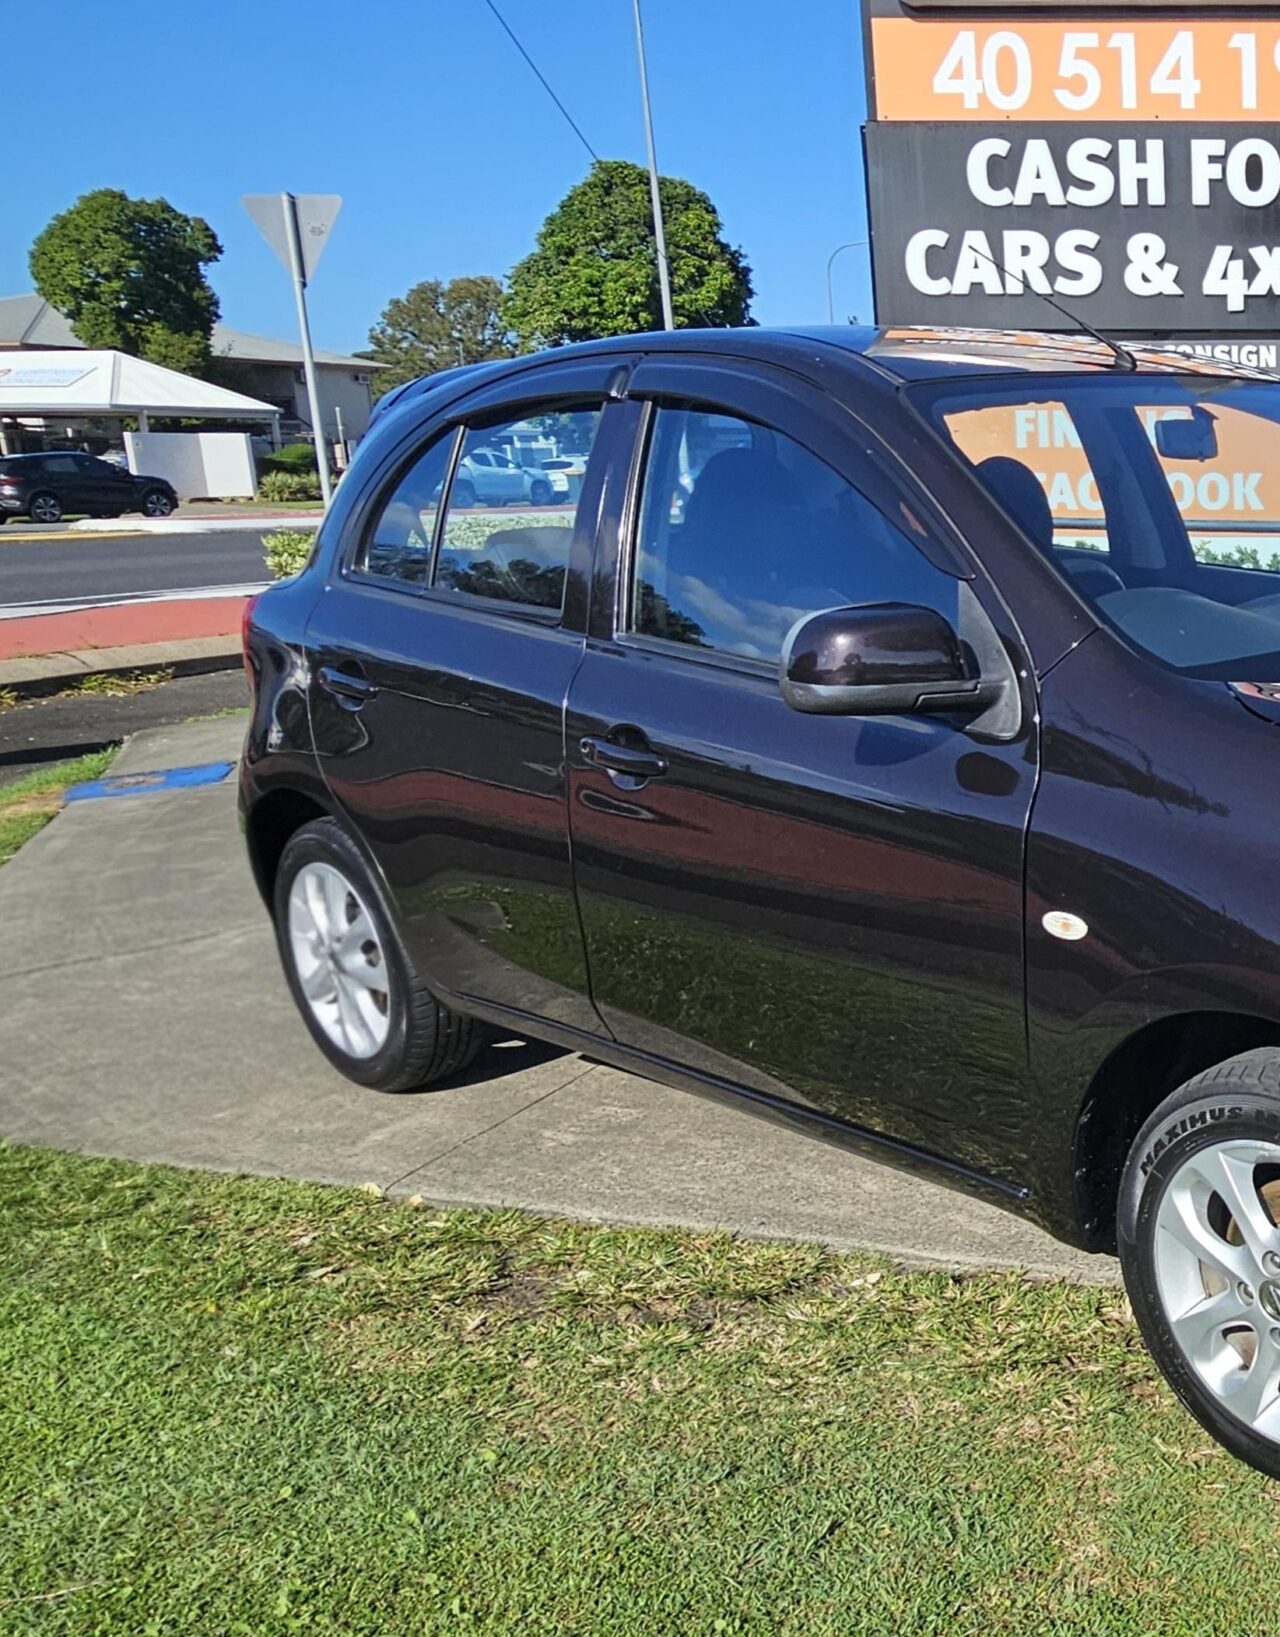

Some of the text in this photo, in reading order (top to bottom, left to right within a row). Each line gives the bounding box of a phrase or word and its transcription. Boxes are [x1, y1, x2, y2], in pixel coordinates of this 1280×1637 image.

[933, 30, 1032, 110] 40
[1053, 31, 1200, 109] 514
[966, 138, 1165, 206] CASH
[905, 229, 1102, 296] CARS
[1124, 231, 1183, 296] &
[1015, 410, 1084, 448] FIN
[1140, 1107, 1243, 1176] MAXIMUS
